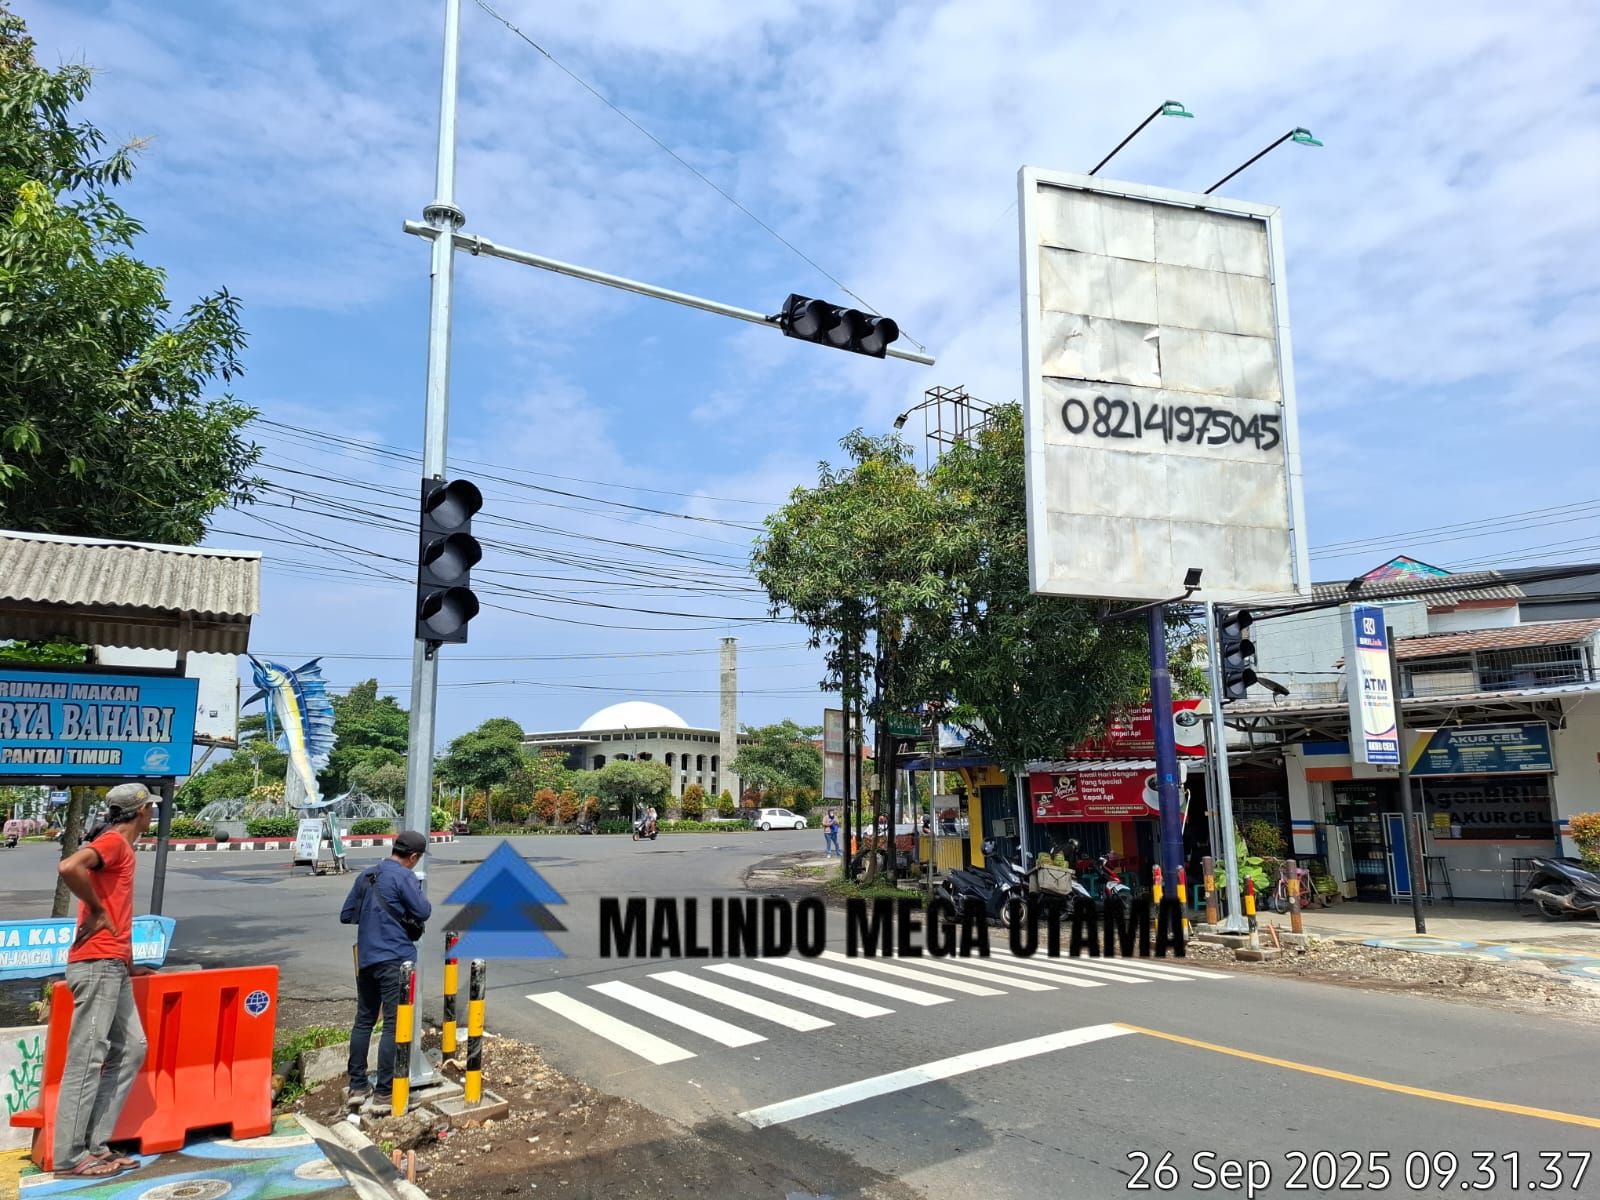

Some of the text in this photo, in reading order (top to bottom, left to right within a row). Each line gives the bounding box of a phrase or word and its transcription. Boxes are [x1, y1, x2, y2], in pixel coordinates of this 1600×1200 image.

[1061, 396, 1280, 450] 082141975045
[71, 685, 139, 701] MAKAN
[1364, 678, 1388, 692] ATM
[60, 704, 174, 743] BAHARI
[1491, 733, 1529, 742] CELL
[1, 748, 121, 765] PANTAI TIMUR
